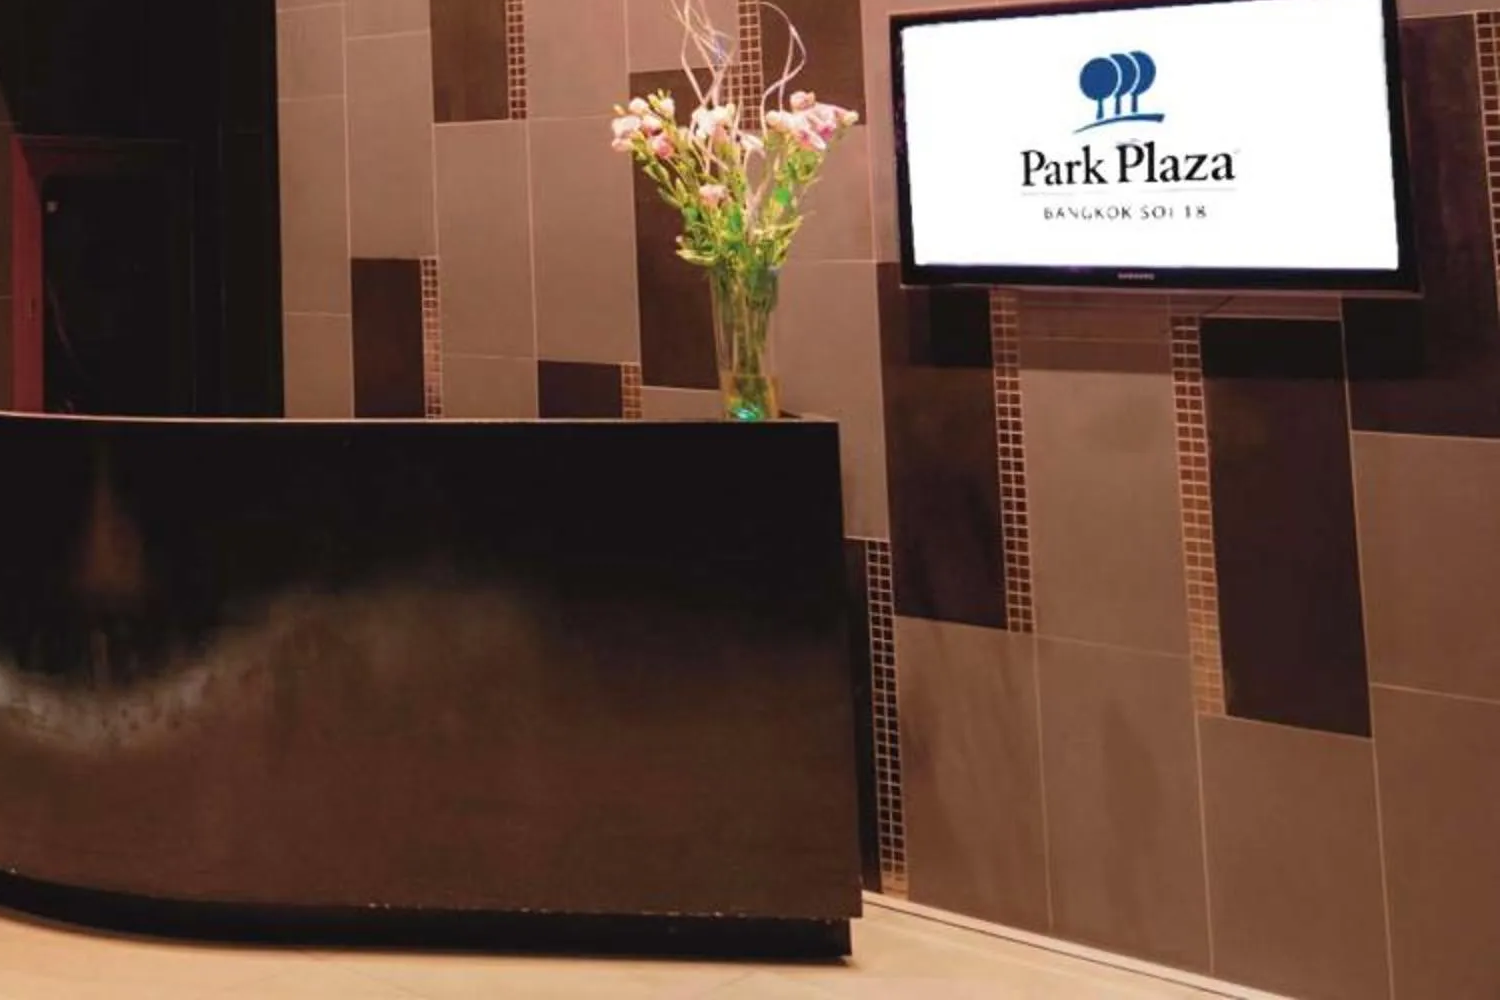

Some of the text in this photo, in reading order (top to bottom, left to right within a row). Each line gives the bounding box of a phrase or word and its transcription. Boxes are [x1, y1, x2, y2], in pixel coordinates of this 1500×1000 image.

[1020, 141, 1236, 187] Park Plaza
[1043, 205, 1132, 221] BANGKOK
[1185, 204, 1207, 219] 18
